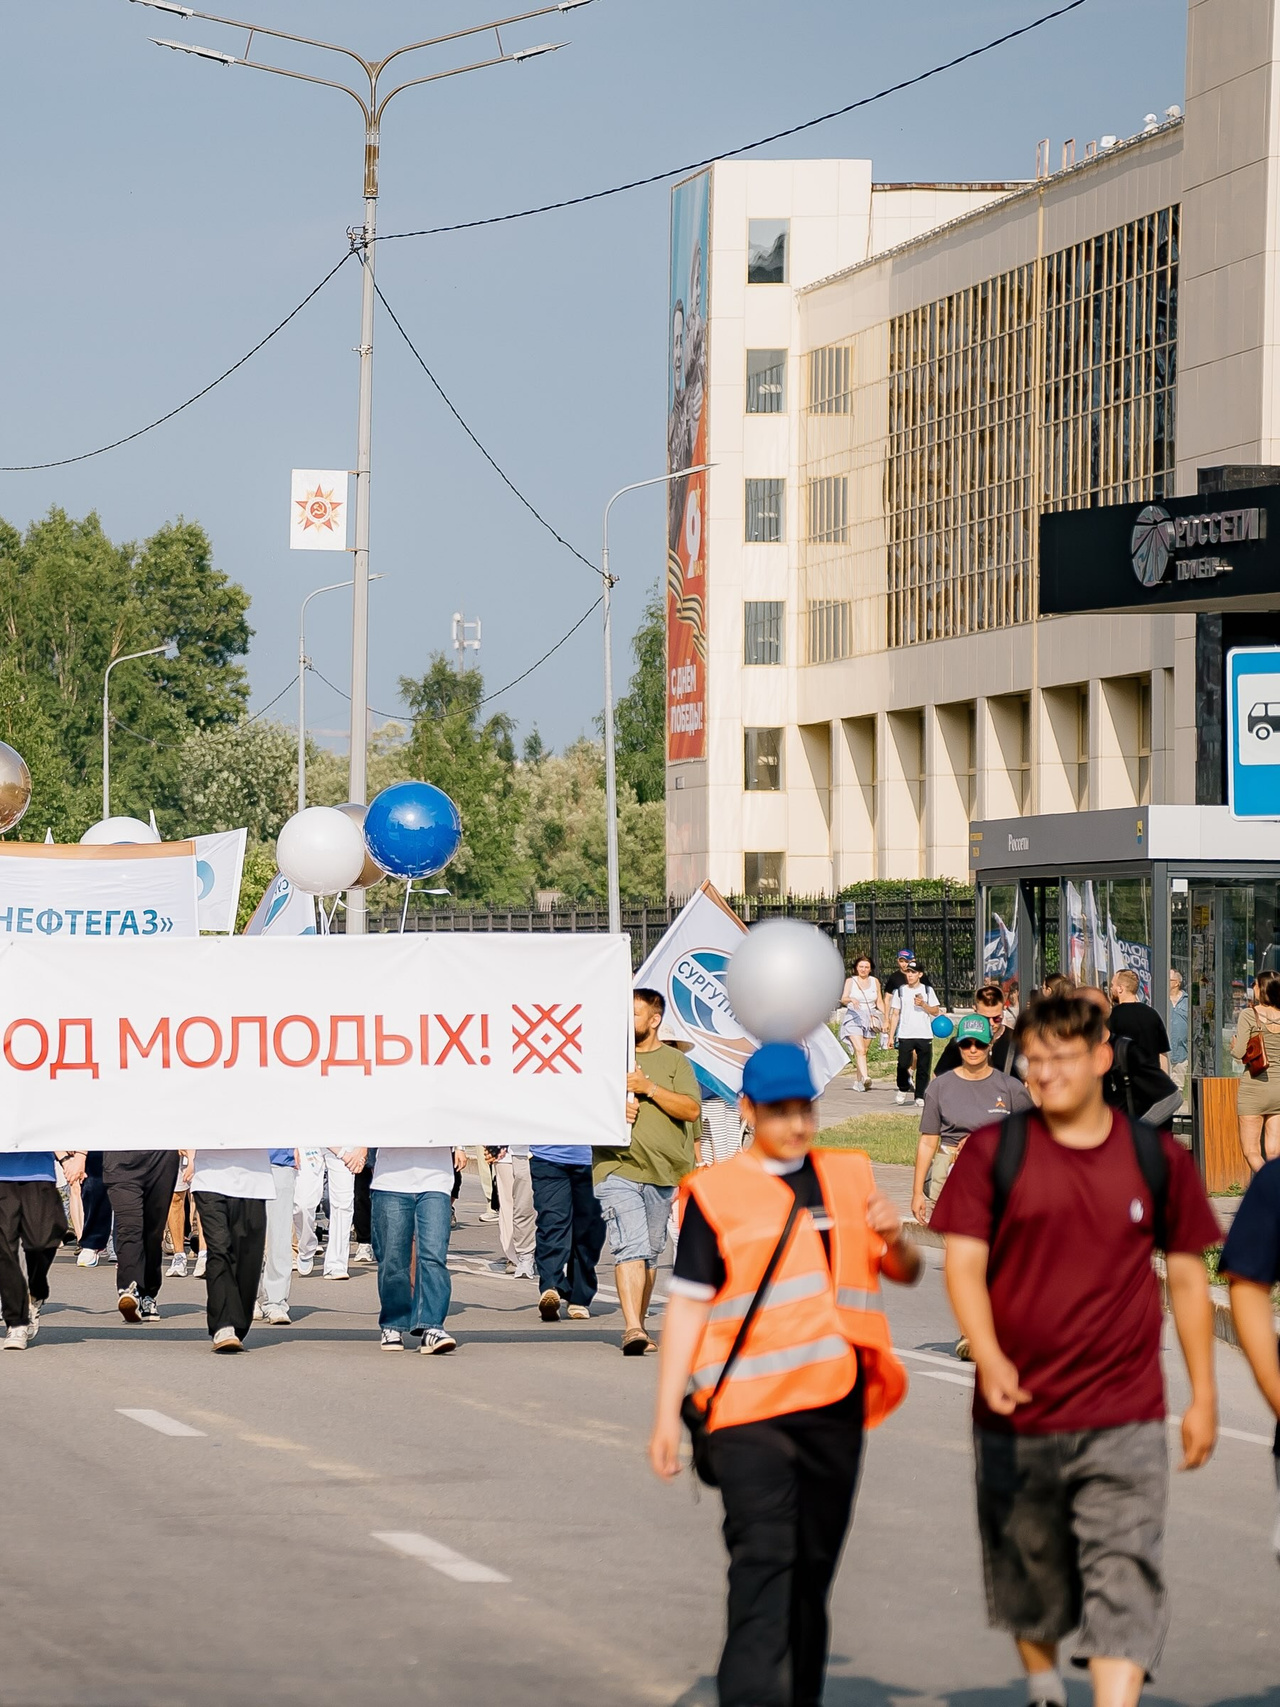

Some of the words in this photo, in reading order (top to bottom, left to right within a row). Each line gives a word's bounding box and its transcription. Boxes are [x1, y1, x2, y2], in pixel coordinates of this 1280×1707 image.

[686, 490, 701, 578] 9
[1175, 508, 1261, 548] РОССЕТИ
[670, 668, 677, 695] С
[677, 658, 697, 699] ДНЁМ
[670, 701, 703, 736] ПОБЕДЫ!
[118, 1014, 492, 1077] МОЛОДЫХ!
